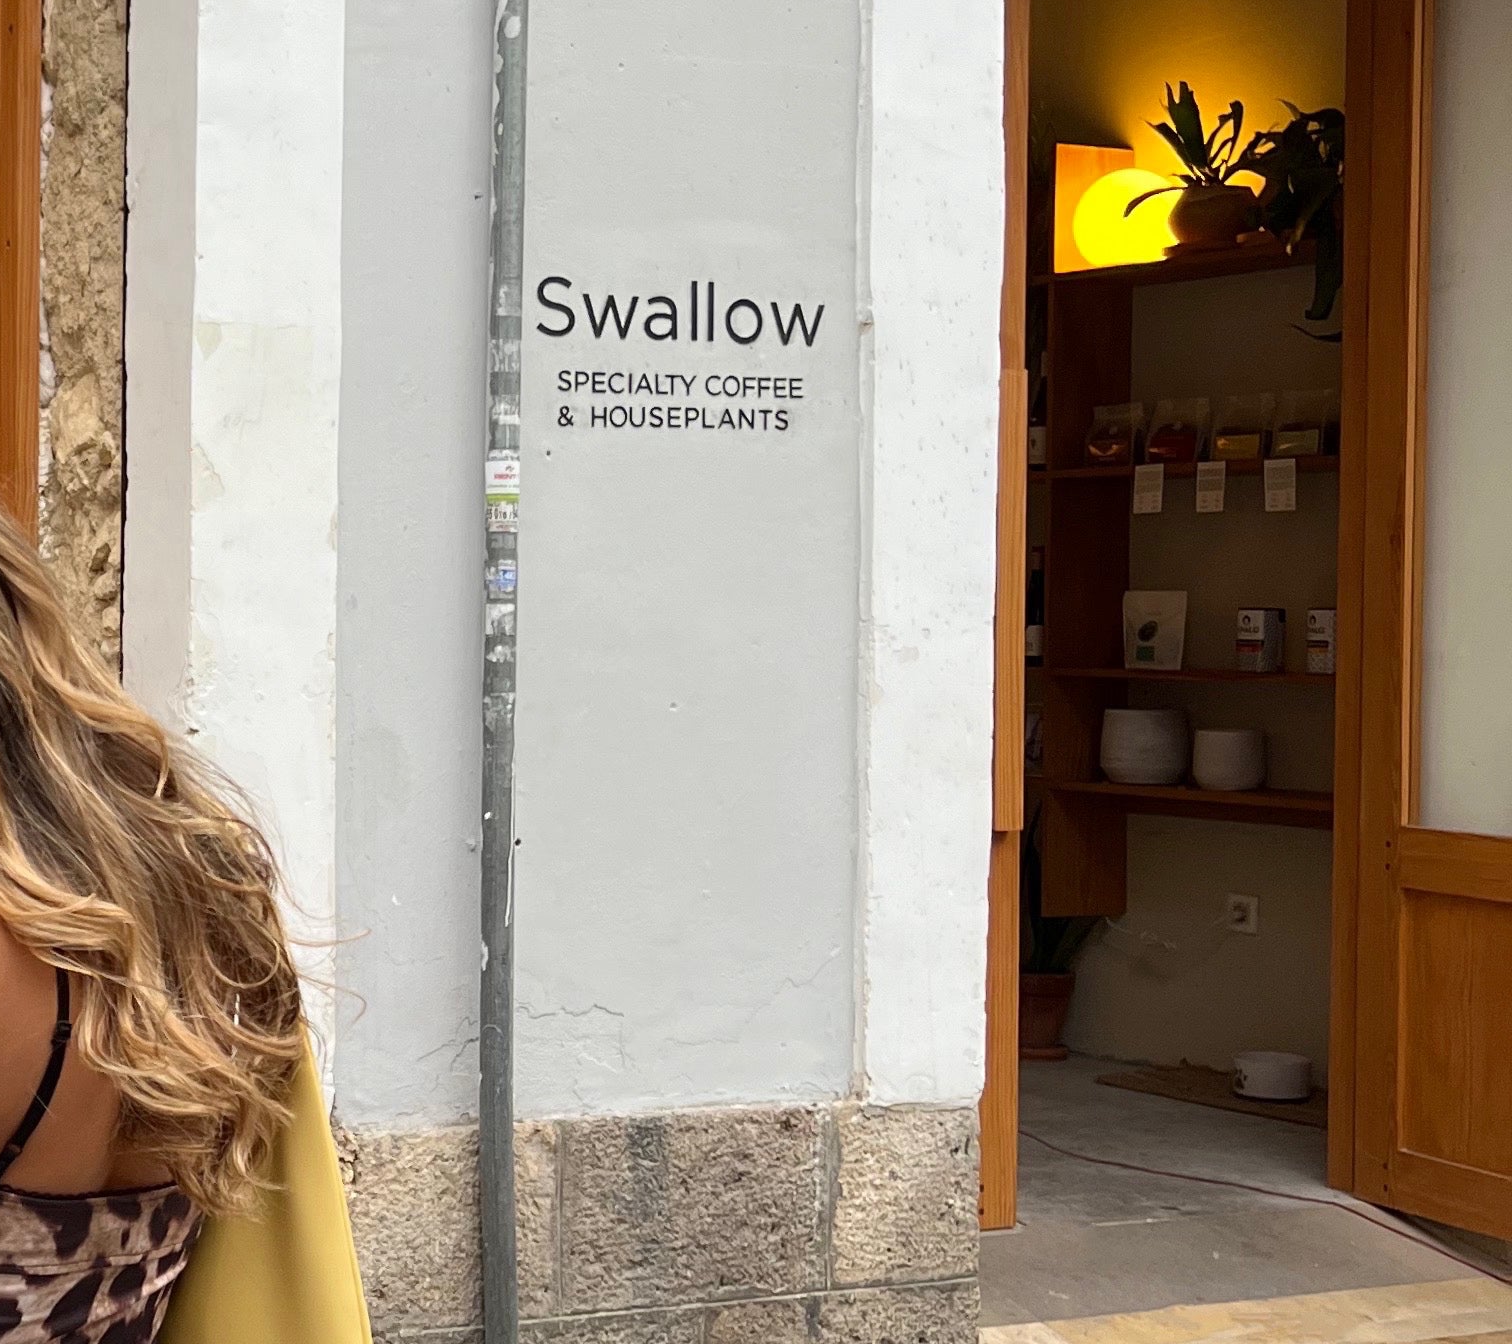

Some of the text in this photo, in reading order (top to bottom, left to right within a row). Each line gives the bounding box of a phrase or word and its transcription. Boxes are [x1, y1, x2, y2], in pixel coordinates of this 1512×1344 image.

[536, 276, 826, 347] Swallow
[557, 369, 804, 399] SPECIALTY COFFEE
[557, 405, 789, 431] & HOUSEPLANTS
